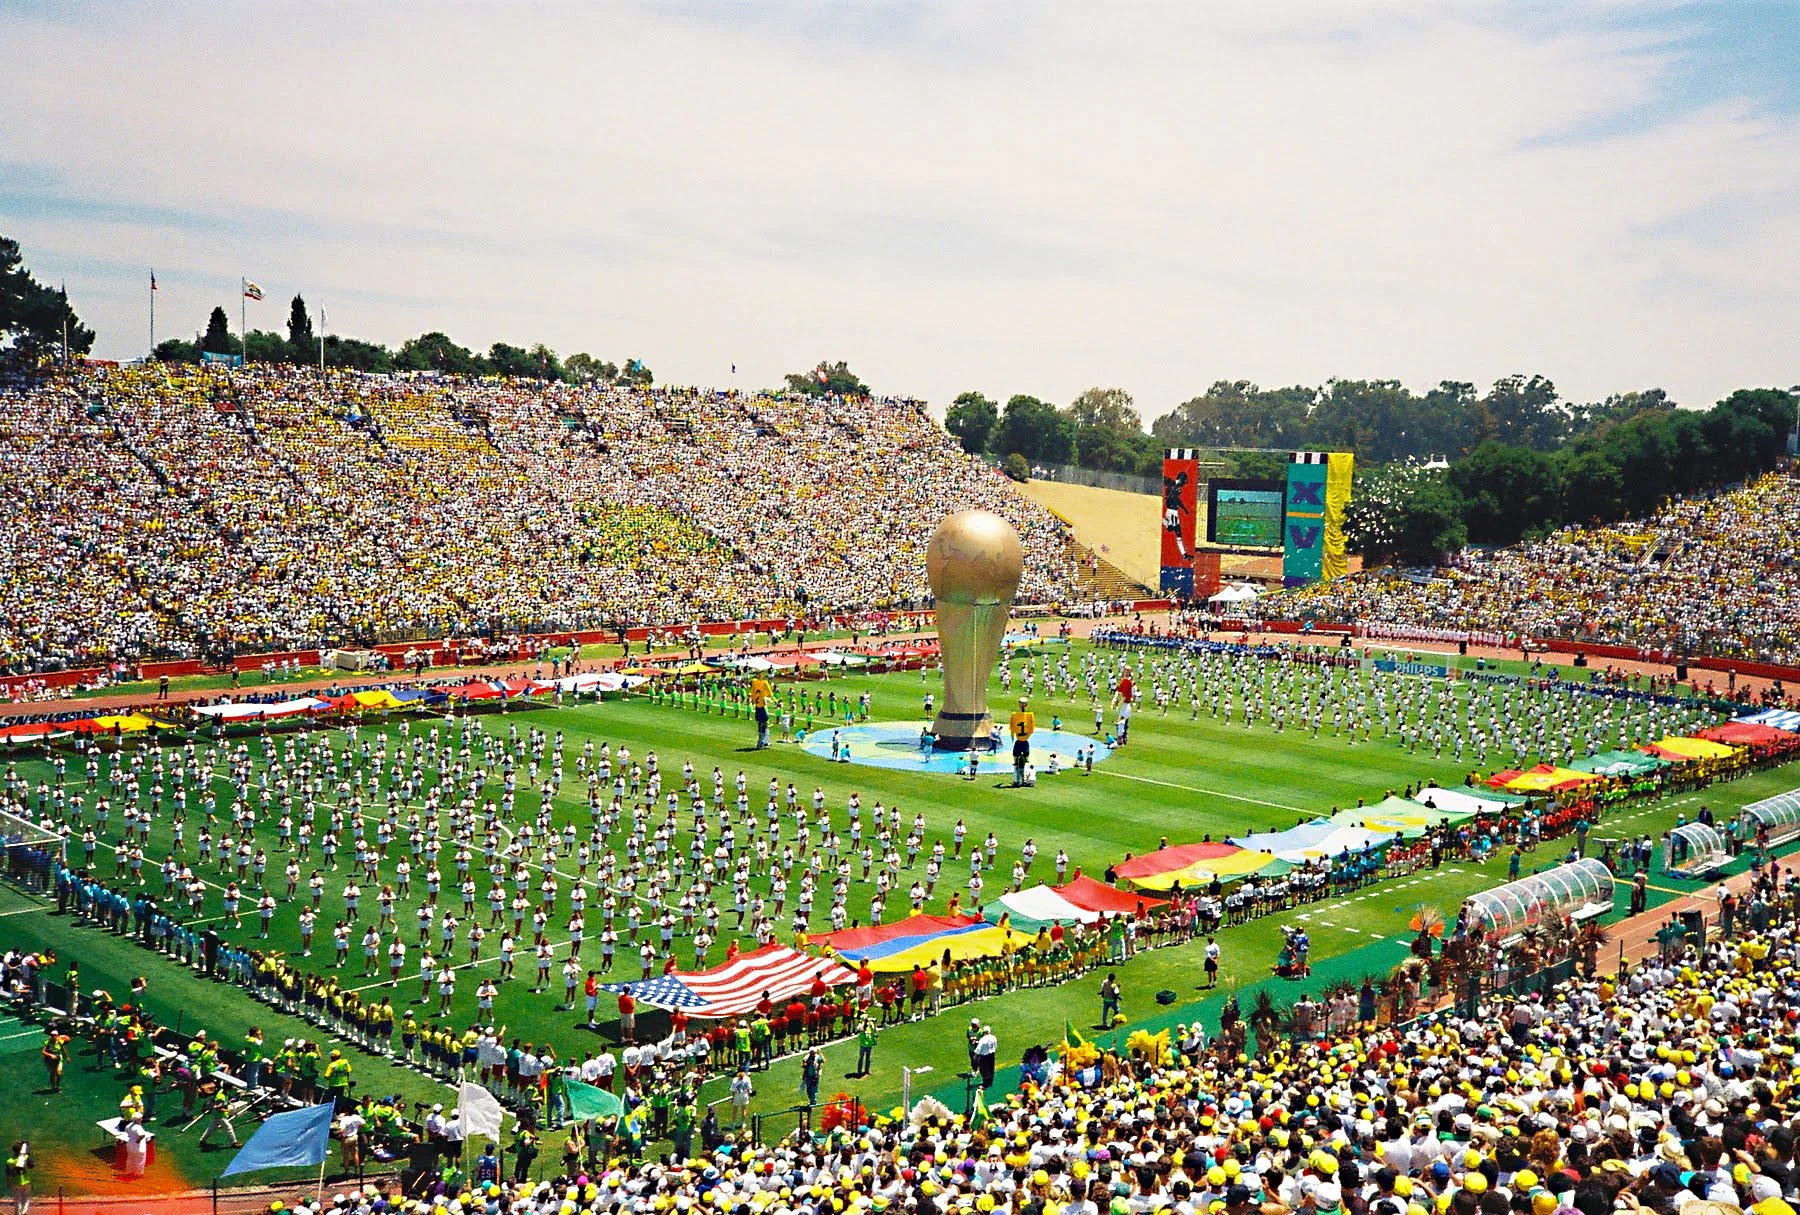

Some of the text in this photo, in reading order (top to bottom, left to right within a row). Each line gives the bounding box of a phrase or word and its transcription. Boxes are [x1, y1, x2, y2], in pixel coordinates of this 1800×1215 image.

[1292, 483, 1324, 504] X
[1288, 526, 1320, 548] V
[1394, 663, 1439, 677] PHILIPS
[1464, 671, 1521, 686] MasterCard
[1017, 722, 1028, 736] 1
